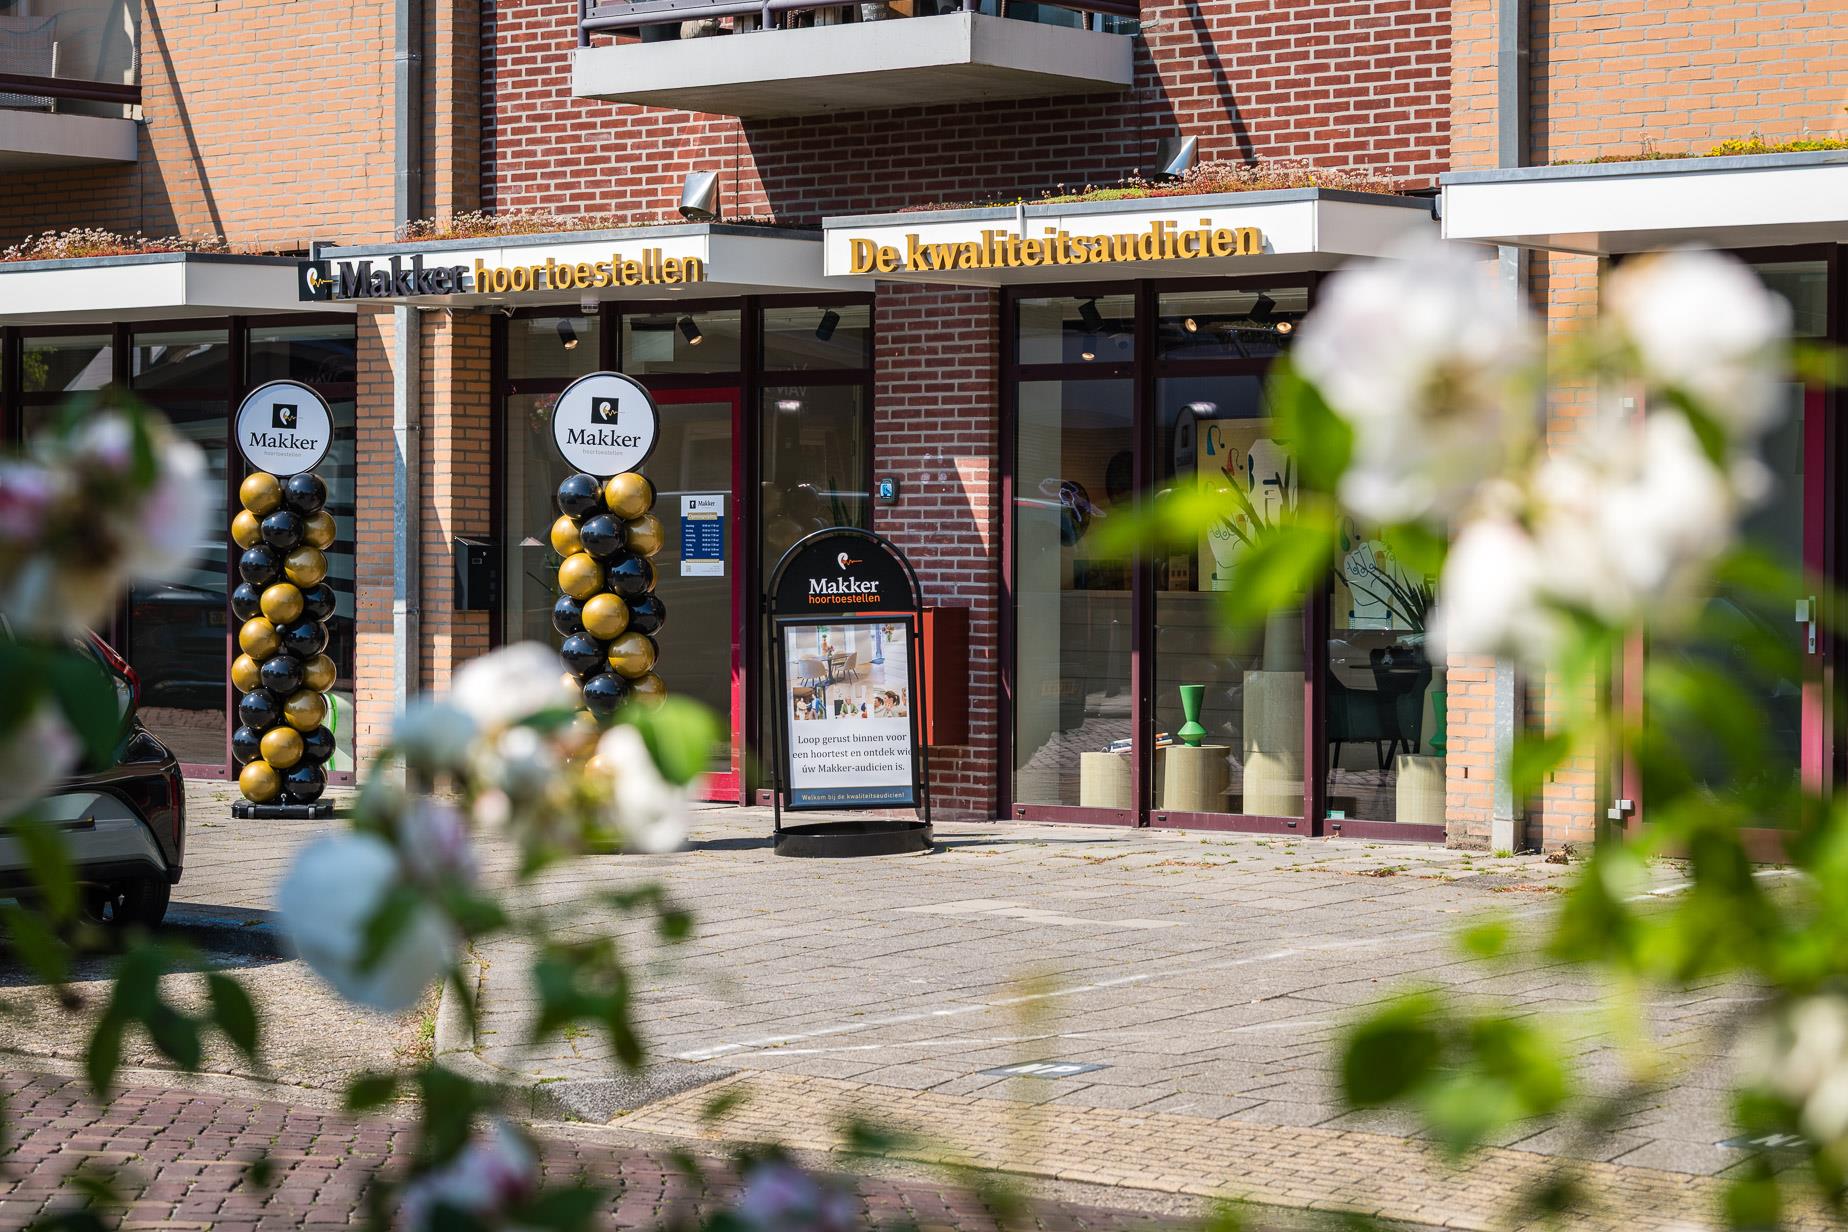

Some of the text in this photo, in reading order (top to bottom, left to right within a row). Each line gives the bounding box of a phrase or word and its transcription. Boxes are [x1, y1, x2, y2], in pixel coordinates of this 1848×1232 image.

[849, 217, 1263, 274] De kwaliteitsaudicien
[336, 247, 704, 299] Makker hoortoestellen
[248, 431, 318, 451] Makker
[565, 427, 642, 448] Makker
[808, 576, 880, 595] Makker
[808, 593, 881, 604] hoortoestellen
[798, 733, 907, 746] Loop gerust binnen voor
[810, 749, 848, 759] hoortest
[850, 750, 861, 758] en
[863, 748, 895, 757] ontdek
[802, 762, 905, 774] úw Makker-audicien is.
